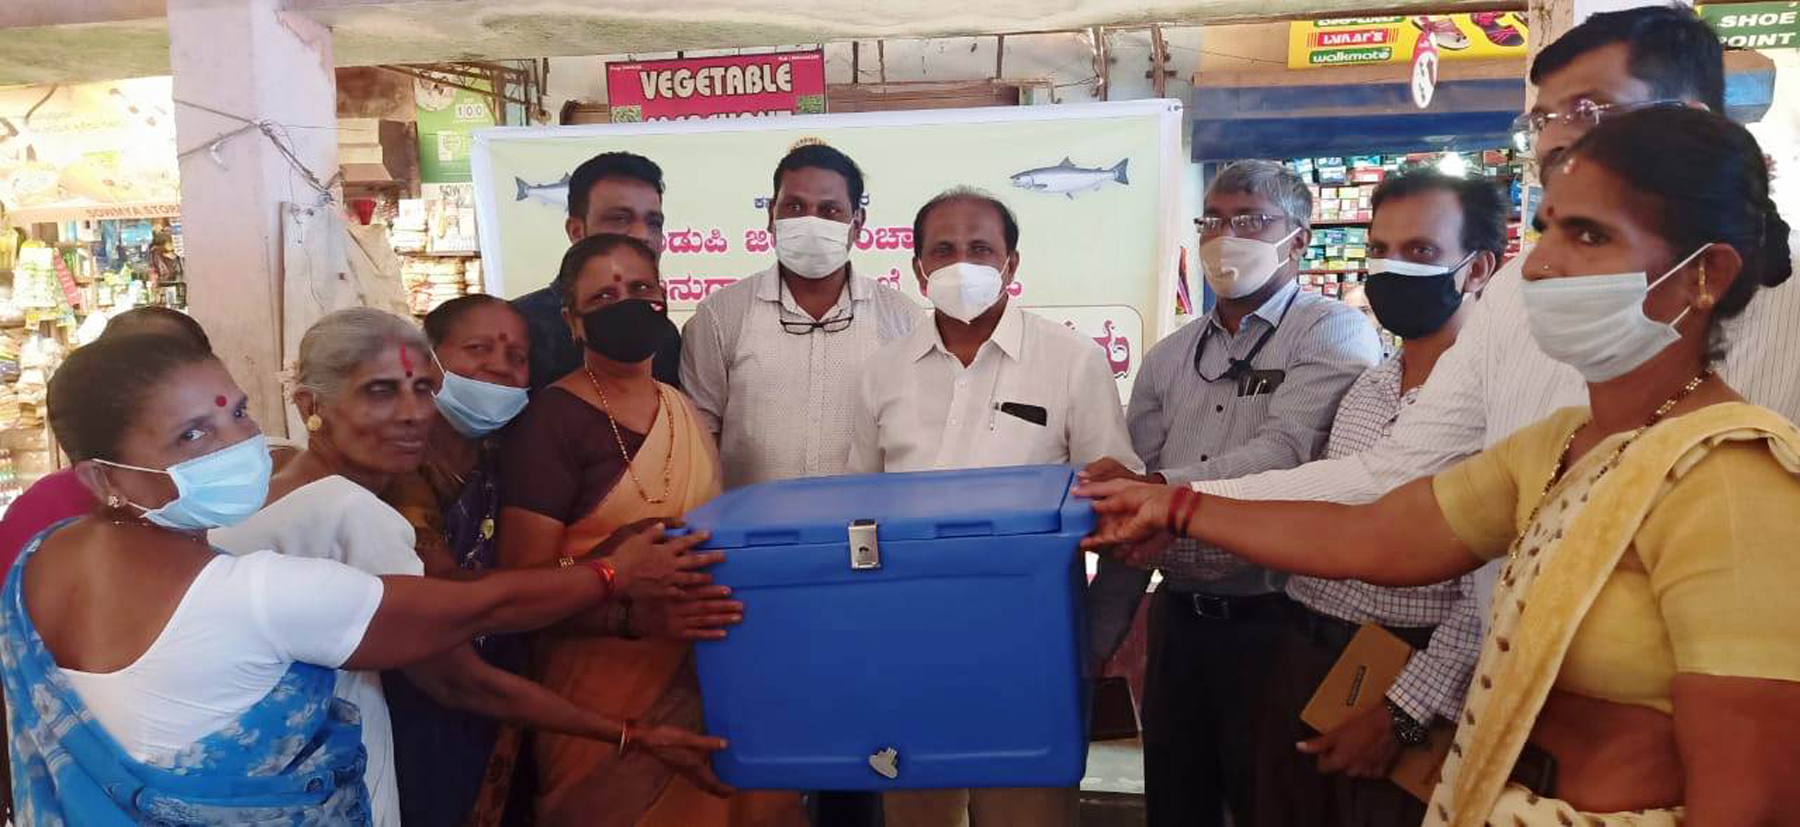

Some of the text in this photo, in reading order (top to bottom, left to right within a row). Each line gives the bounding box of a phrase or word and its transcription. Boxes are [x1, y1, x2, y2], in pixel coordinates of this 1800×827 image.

[1718, 12, 1797, 28] SHOE
[1312, 49, 1390, 63] walkmate
[639, 63, 792, 100] VEGETABLE
